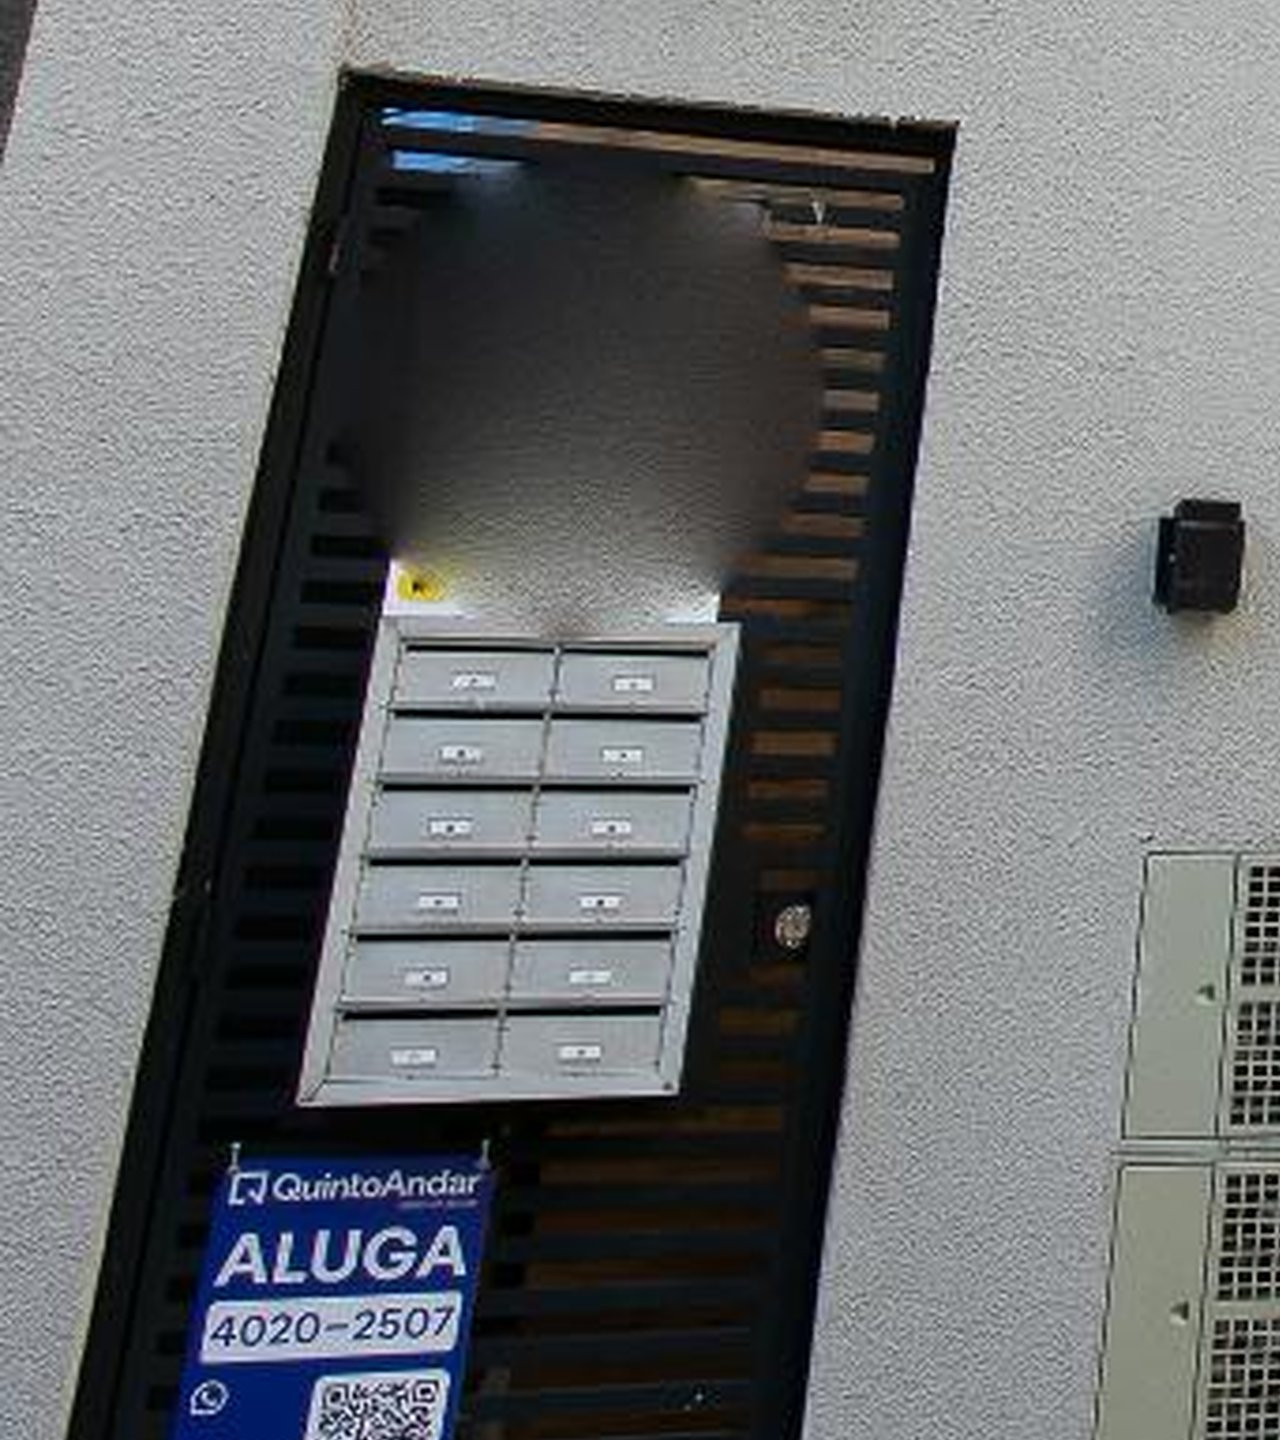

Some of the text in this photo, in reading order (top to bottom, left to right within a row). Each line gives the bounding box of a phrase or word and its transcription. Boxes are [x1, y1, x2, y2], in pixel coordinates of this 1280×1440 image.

[272, 1170, 481, 1202] QuintoAndar
[213, 1225, 467, 1287] ALUGA
[209, 1306, 455, 1348] 4020-2507
